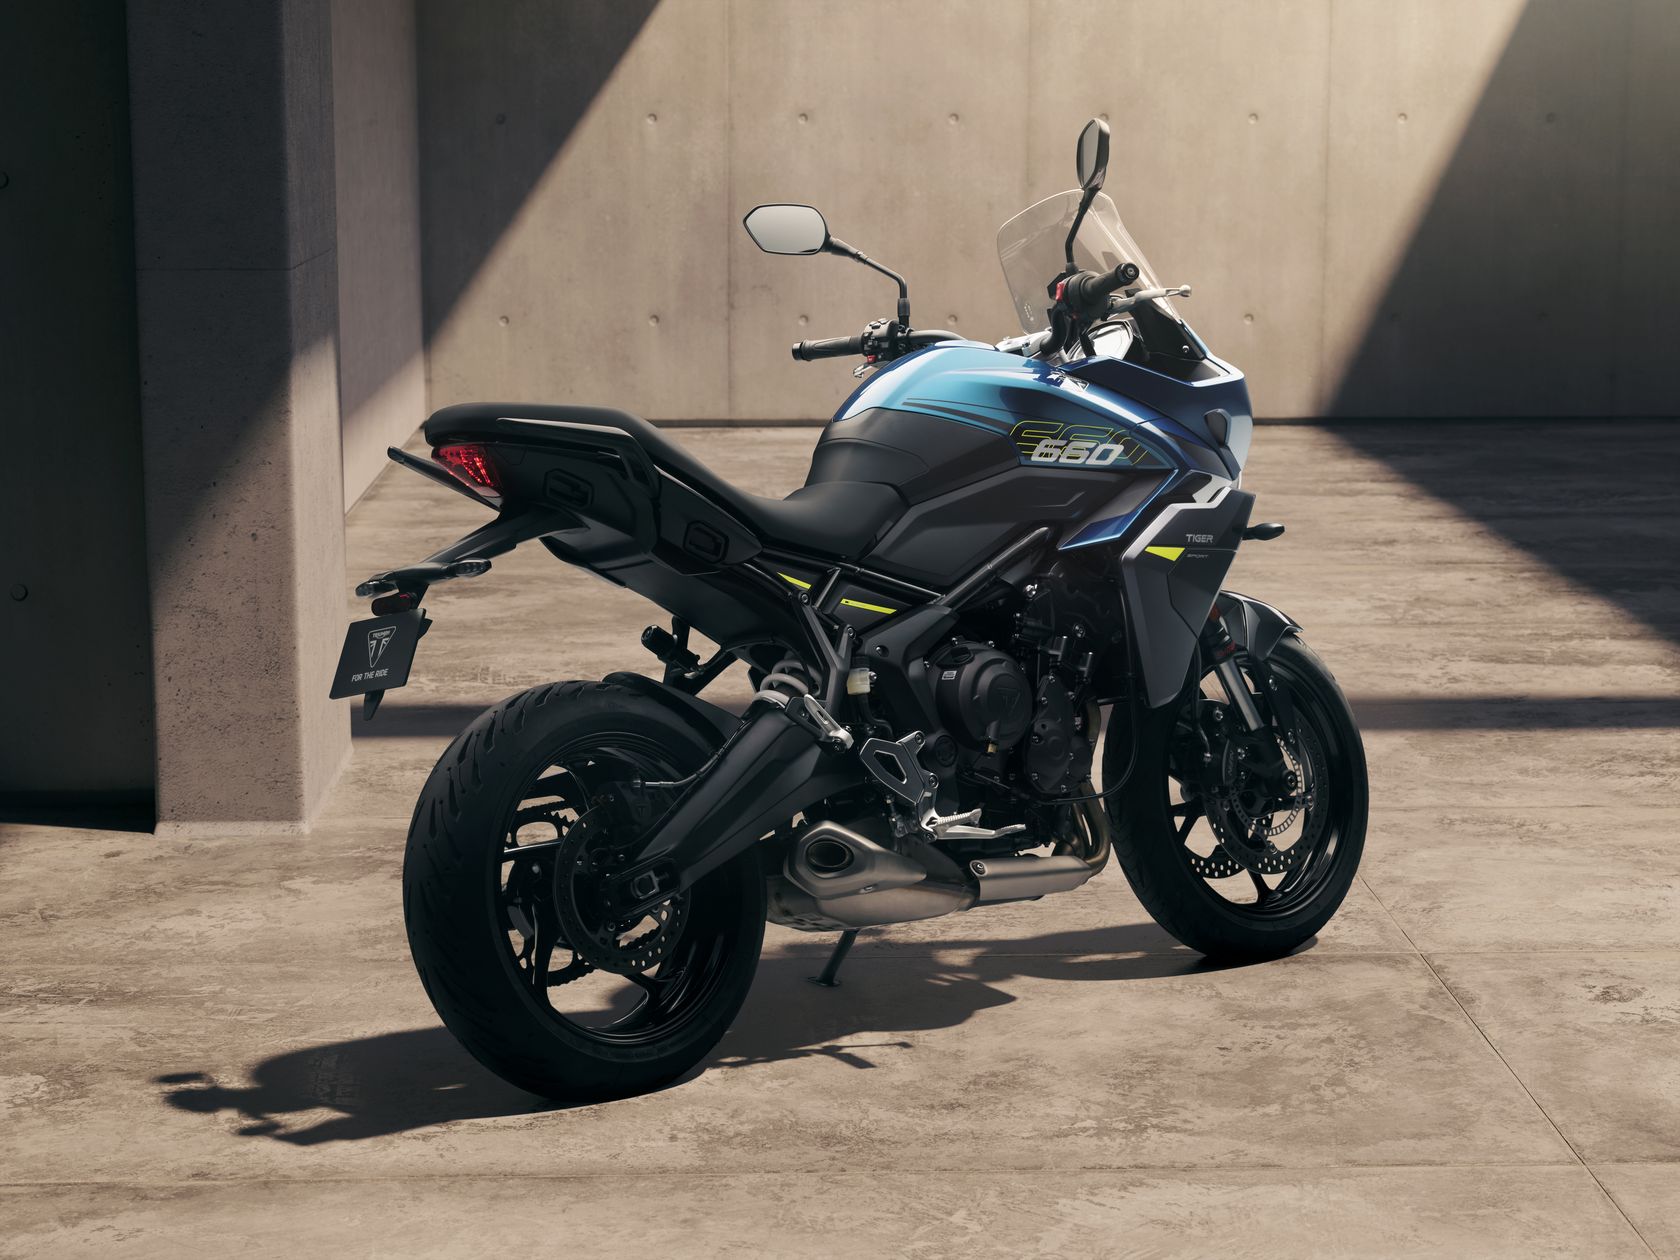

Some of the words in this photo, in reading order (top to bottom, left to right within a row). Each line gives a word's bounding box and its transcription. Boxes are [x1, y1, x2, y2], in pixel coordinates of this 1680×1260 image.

[1030, 439, 1125, 465] 660
[1185, 533, 1214, 544] TIGER
[352, 673, 363, 682] FOR
[364, 671, 375, 680] THE
[375, 669, 389, 678] RIDE
